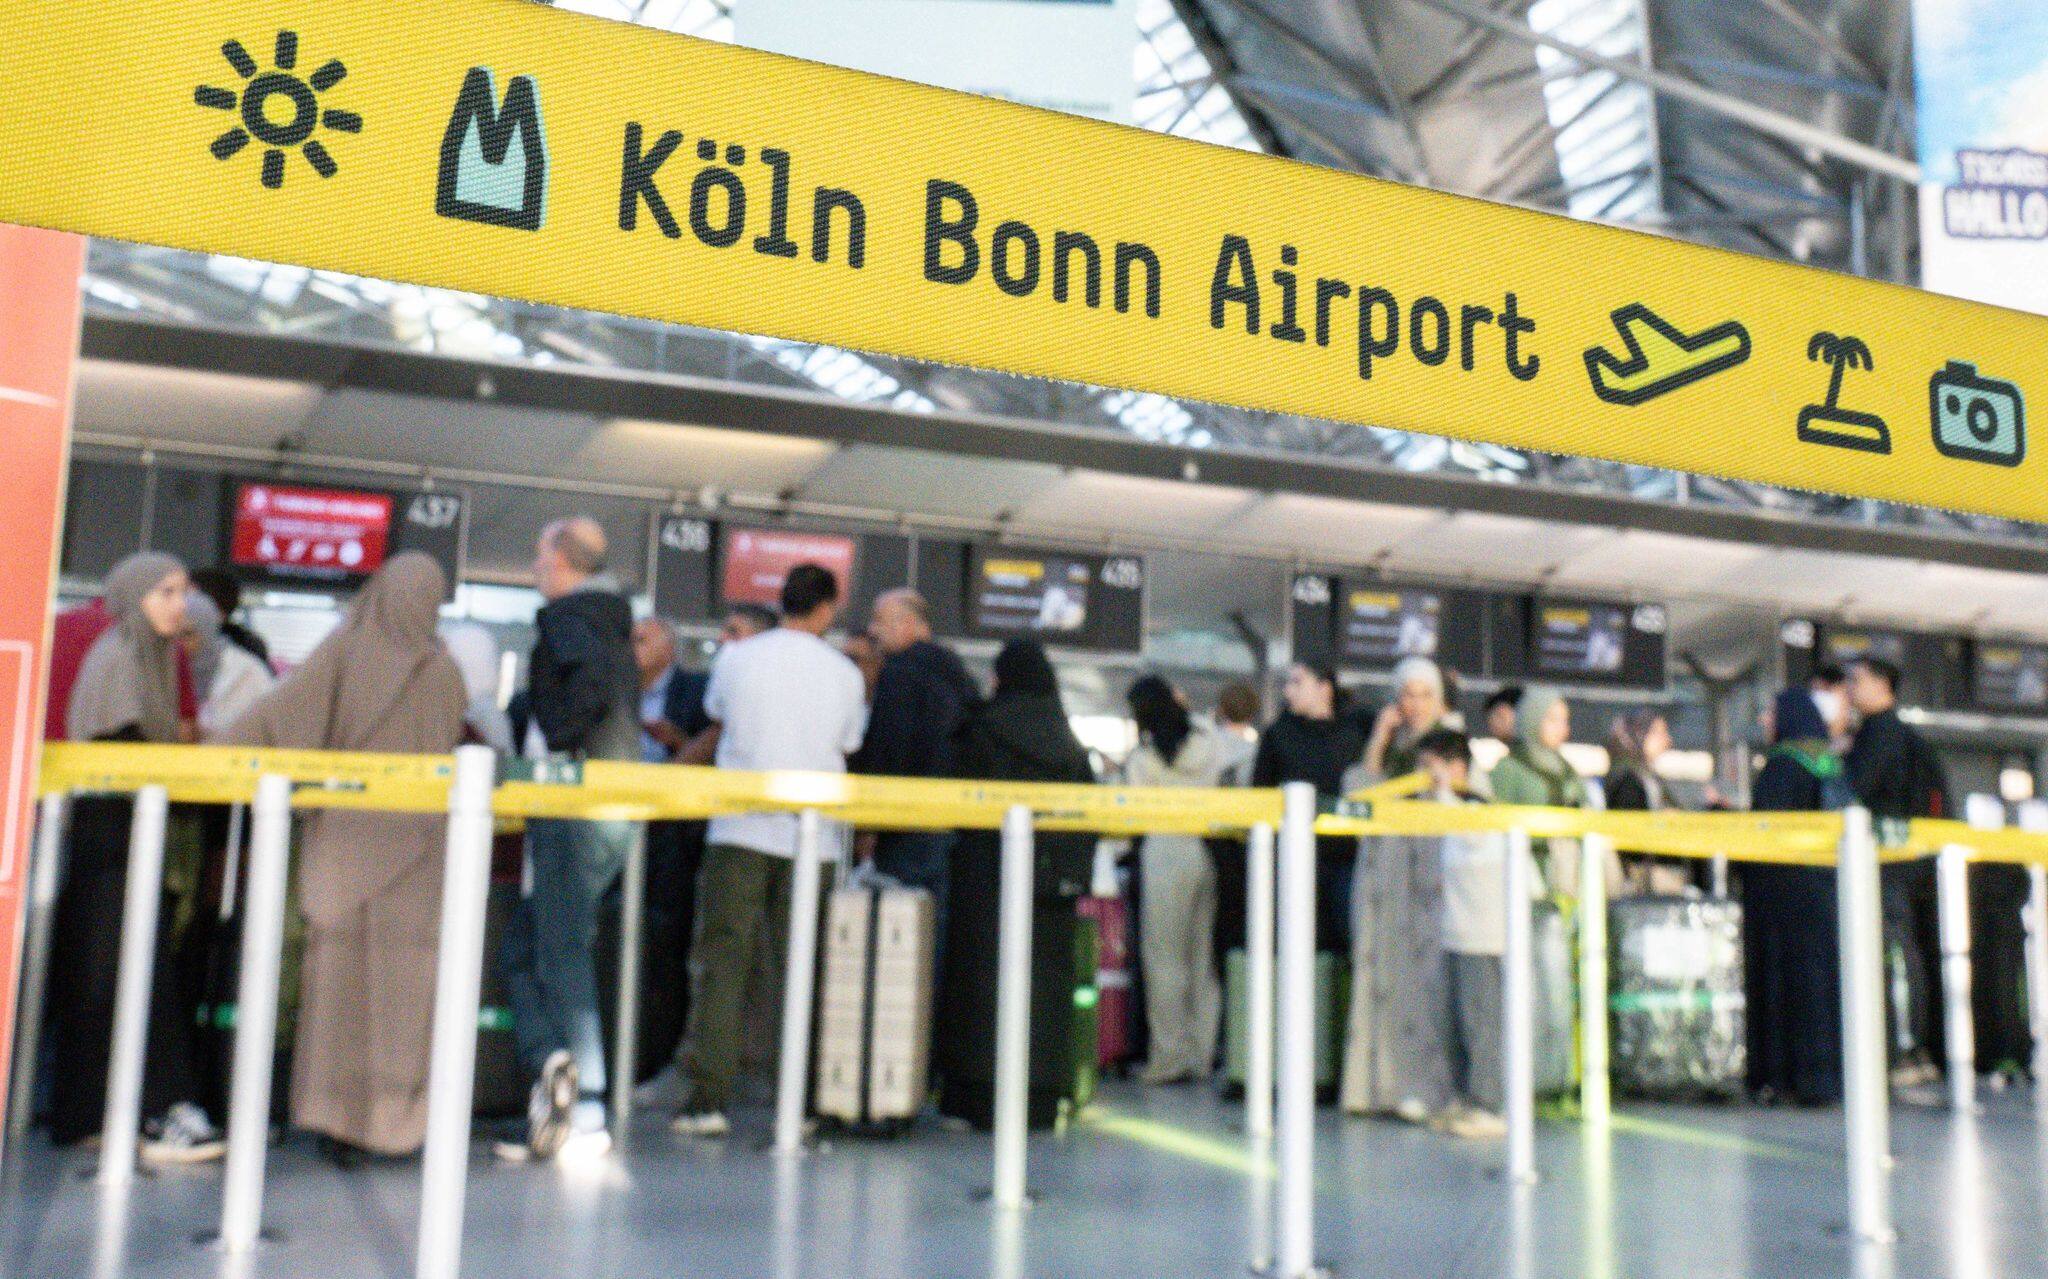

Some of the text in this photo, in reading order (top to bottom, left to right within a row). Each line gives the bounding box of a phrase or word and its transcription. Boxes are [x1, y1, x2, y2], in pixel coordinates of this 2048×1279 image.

[618, 121, 1541, 382] Köln Bonn Airport
[1946, 188, 2048, 236] HALLO
